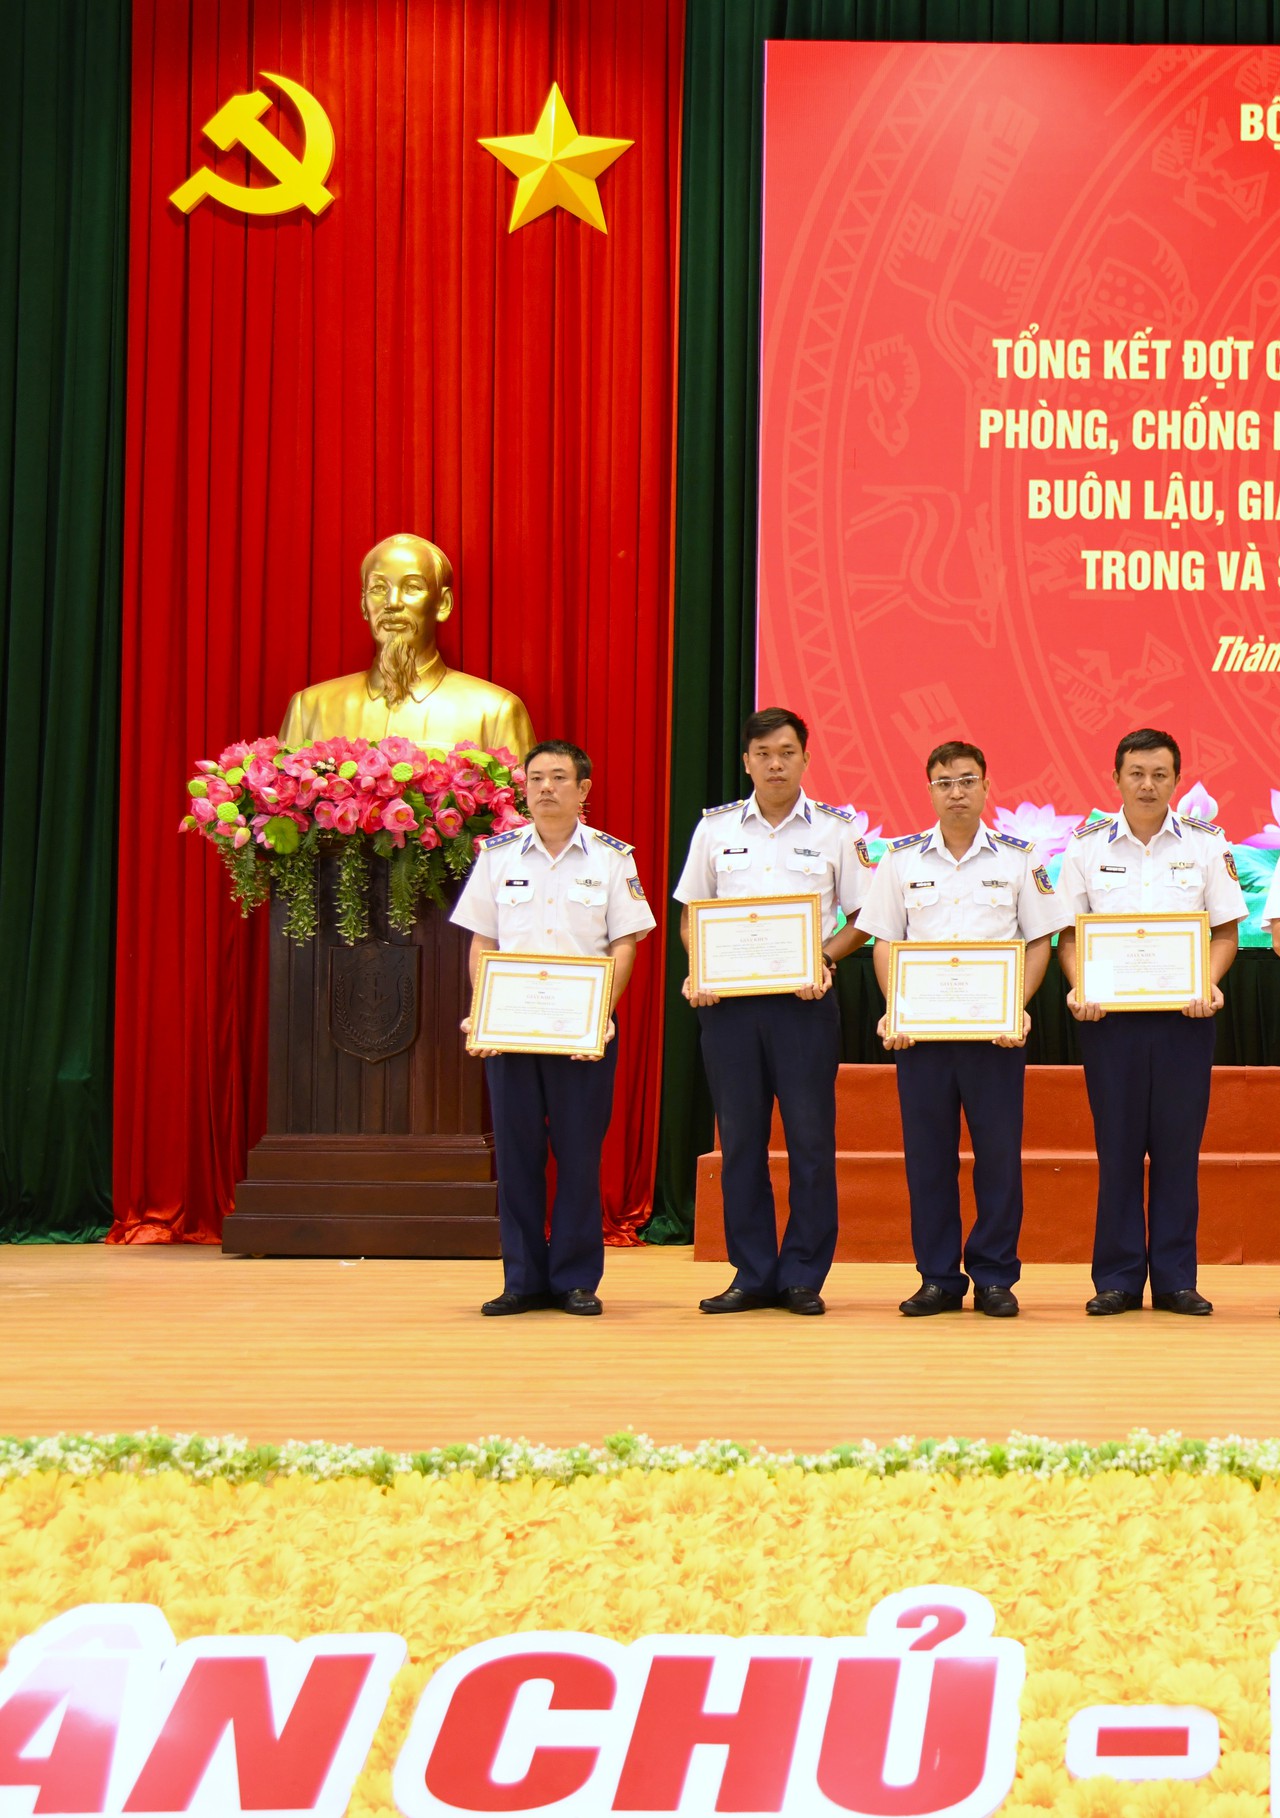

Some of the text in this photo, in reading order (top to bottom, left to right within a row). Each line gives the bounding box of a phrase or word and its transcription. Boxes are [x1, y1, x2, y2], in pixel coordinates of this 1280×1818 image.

[991, 322, 1091, 380] TỔNG
[1103, 326, 1172, 380] KẾT
[1181, 336, 1255, 390] ĐỢT
[979, 399, 1119, 455] PHÒNG,
[1132, 395, 1260, 451] CHỐNG
[1028, 470, 1131, 520] BUÔN
[1143, 471, 1225, 530] LẬU,
[1080, 549, 1205, 592] TRONG
[1217, 542, 1266, 591] VÀ
[424, 1604, 999, 1817] CHỦ
